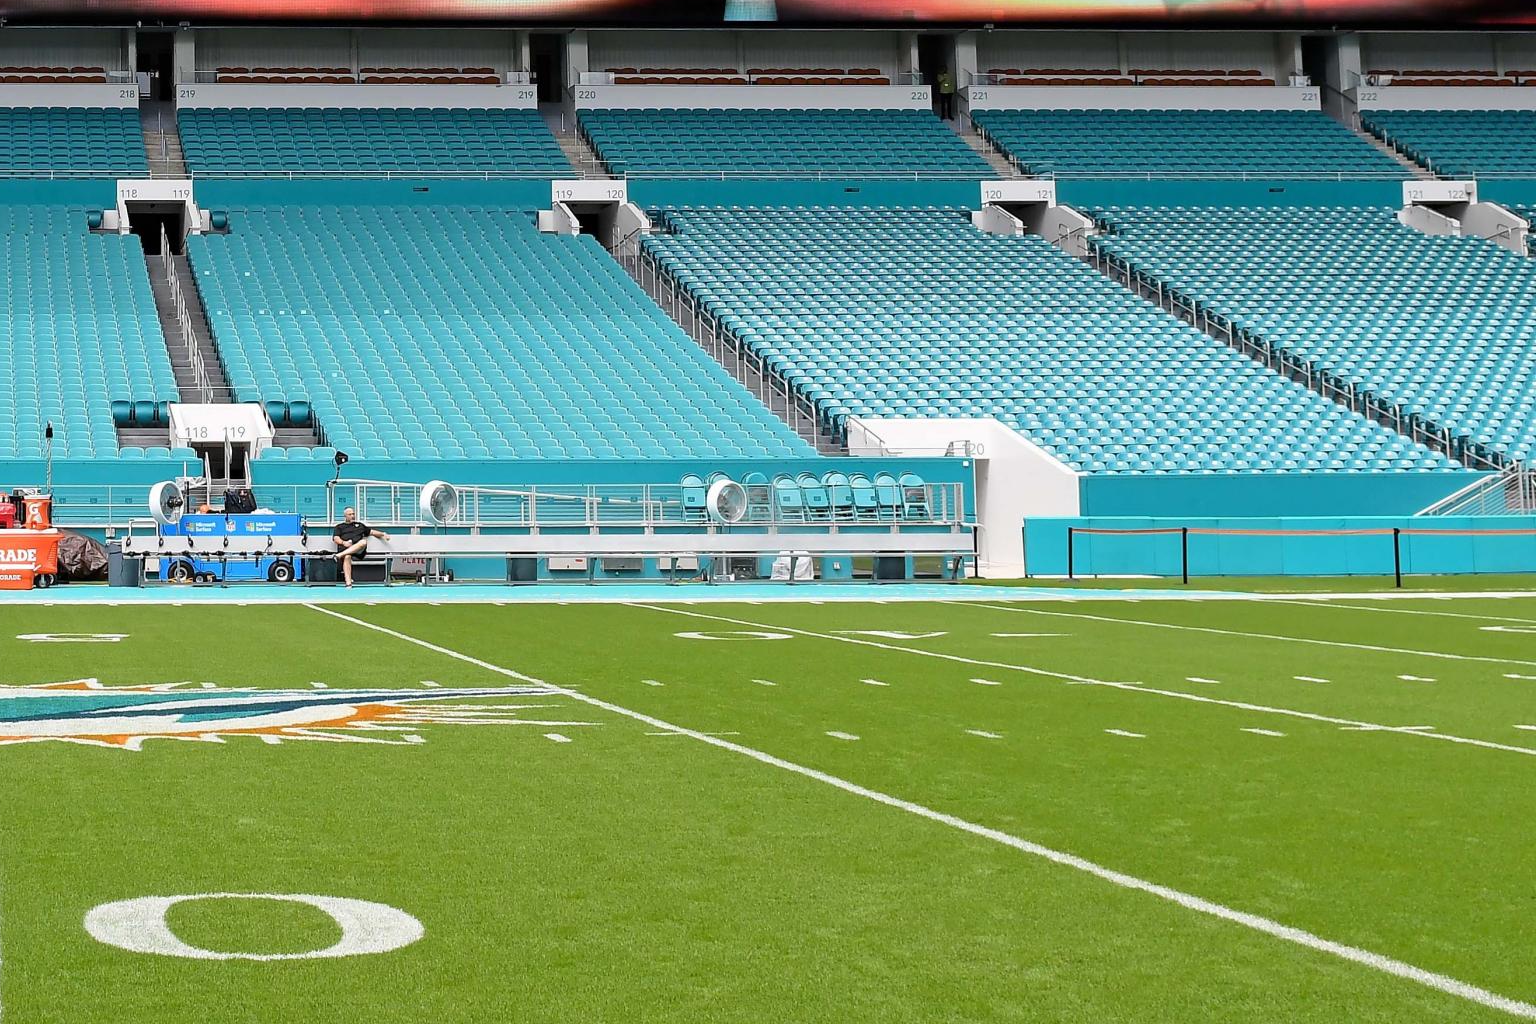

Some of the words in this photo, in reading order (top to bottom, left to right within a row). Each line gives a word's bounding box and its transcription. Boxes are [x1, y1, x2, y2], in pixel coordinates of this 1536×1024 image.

[119, 90, 135, 98] 218
[180, 90, 195, 98] 219
[518, 90, 534, 99] 219
[578, 90, 596, 99] 220
[911, 91, 928, 100] 220
[972, 91, 988, 100] 221
[1301, 93, 1318, 101] 221
[1360, 93, 1377, 101] 222
[121, 189, 138, 198] 118
[173, 189, 190, 198] 119
[556, 190, 573, 199] 119
[608, 190, 624, 199] 120
[985, 190, 1002, 200] 120
[1037, 190, 1053, 199] 121
[1408, 190, 1423, 199] 121
[1448, 190, 1464, 199] 122
[184, 426, 208, 438] 118
[222, 426, 246, 438] 119
[28, 504, 39, 515] G
